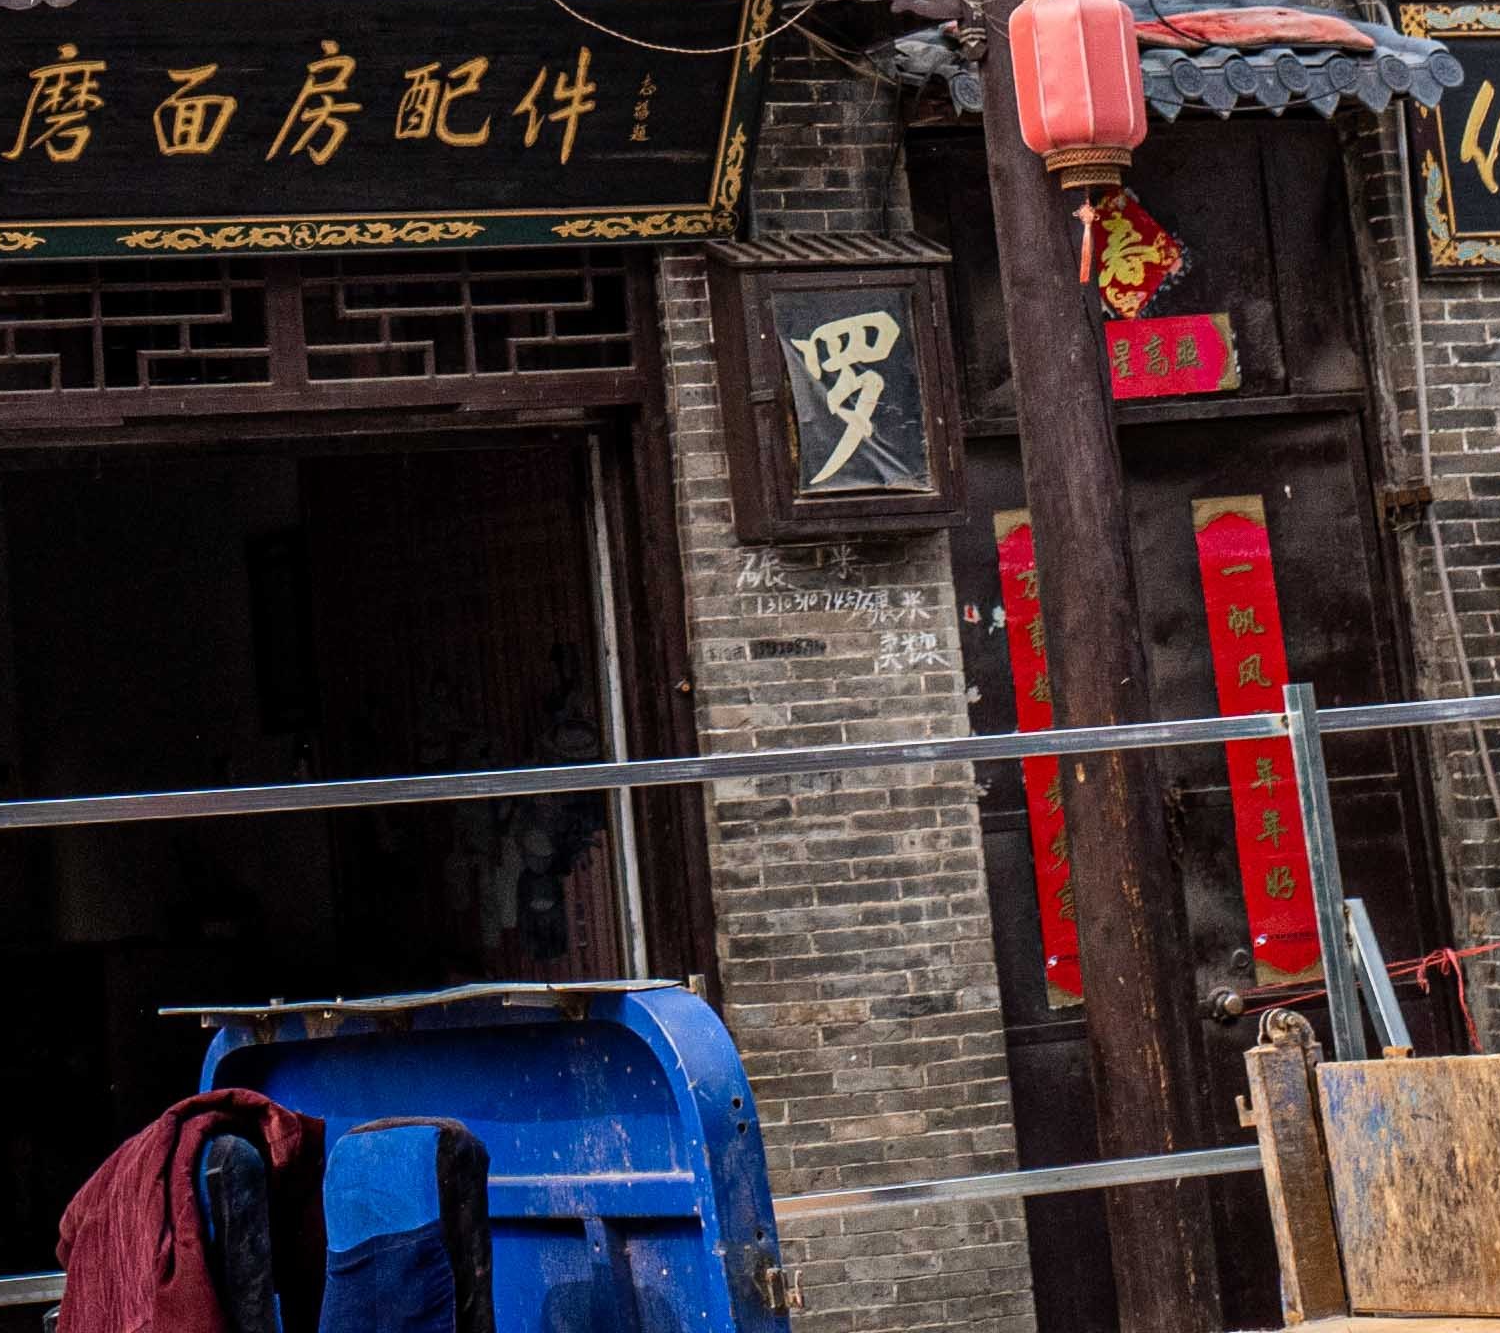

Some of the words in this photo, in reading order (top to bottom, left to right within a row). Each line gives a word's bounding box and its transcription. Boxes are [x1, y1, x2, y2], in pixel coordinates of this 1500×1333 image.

[1, 40, 596, 165] 磨面房配件
[790, 310, 901, 485] 罗
[1221, 562, 1297, 901] 一帆风年年好
